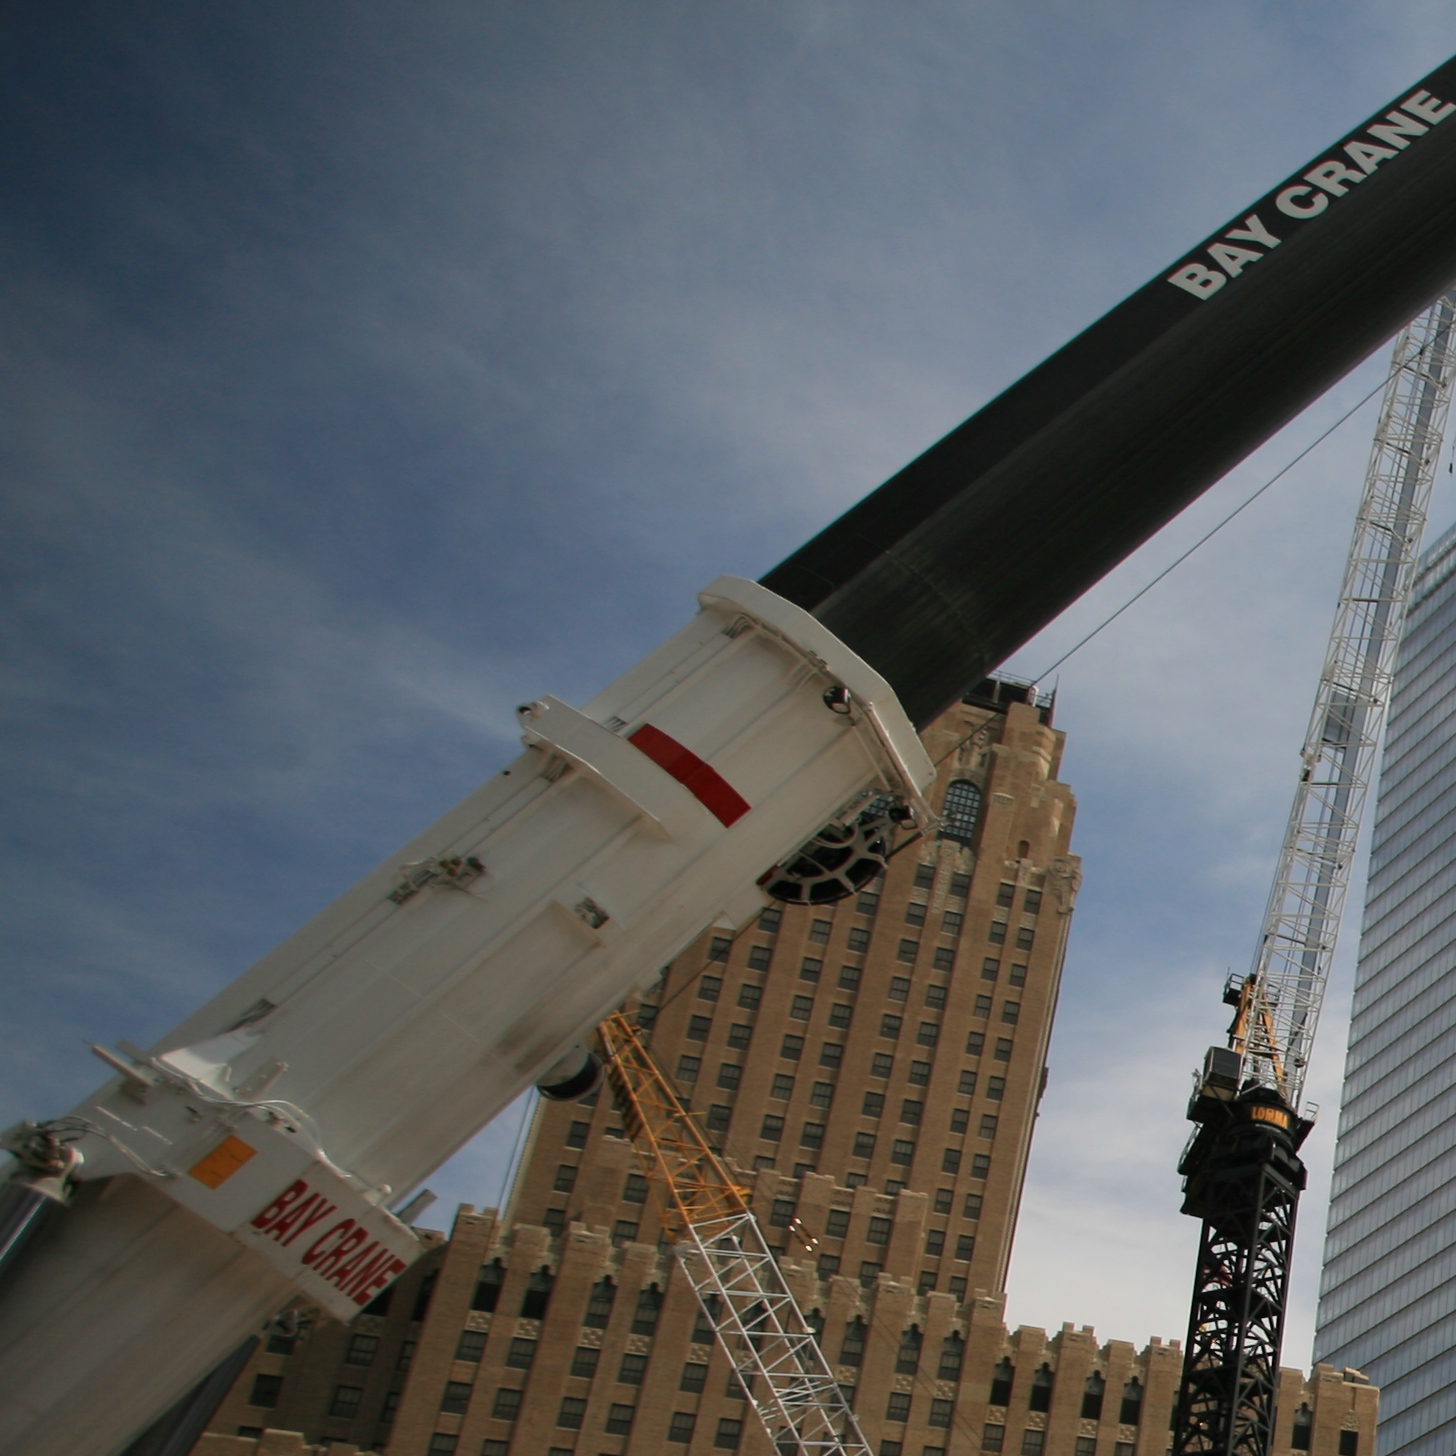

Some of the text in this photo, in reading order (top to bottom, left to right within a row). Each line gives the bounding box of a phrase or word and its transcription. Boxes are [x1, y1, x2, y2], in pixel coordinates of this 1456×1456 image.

[1167, 214, 1282, 300] BAY
[251, 1179, 407, 1306] BAY CRANE
